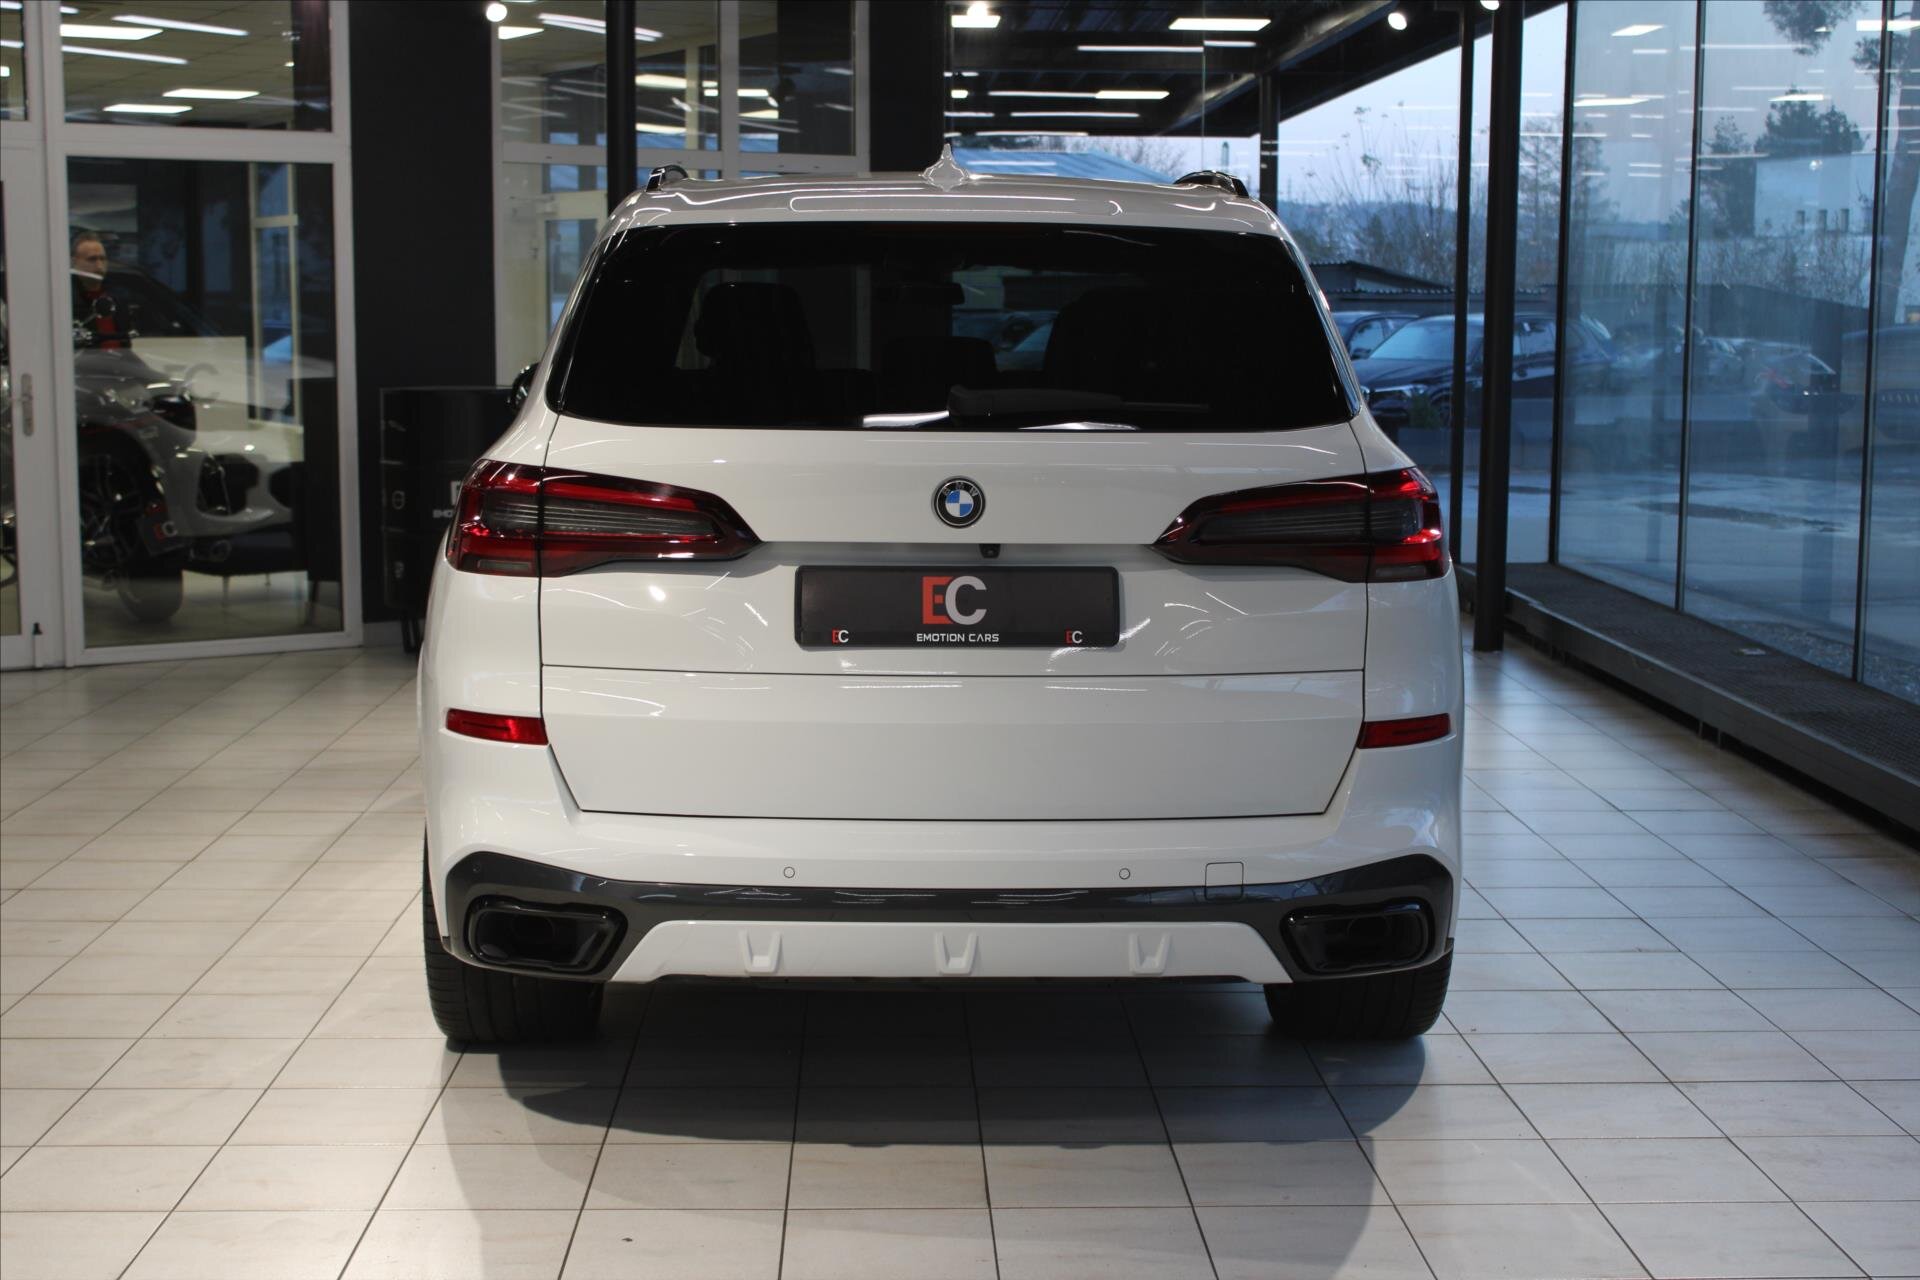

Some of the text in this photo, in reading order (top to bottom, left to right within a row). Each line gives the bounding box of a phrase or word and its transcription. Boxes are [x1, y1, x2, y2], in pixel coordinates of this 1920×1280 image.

[922, 575, 987, 626] EC
[832, 629, 849, 643] EC
[916, 633, 1000, 642] EMOTION CARS
[1065, 630, 1082, 643] EC
